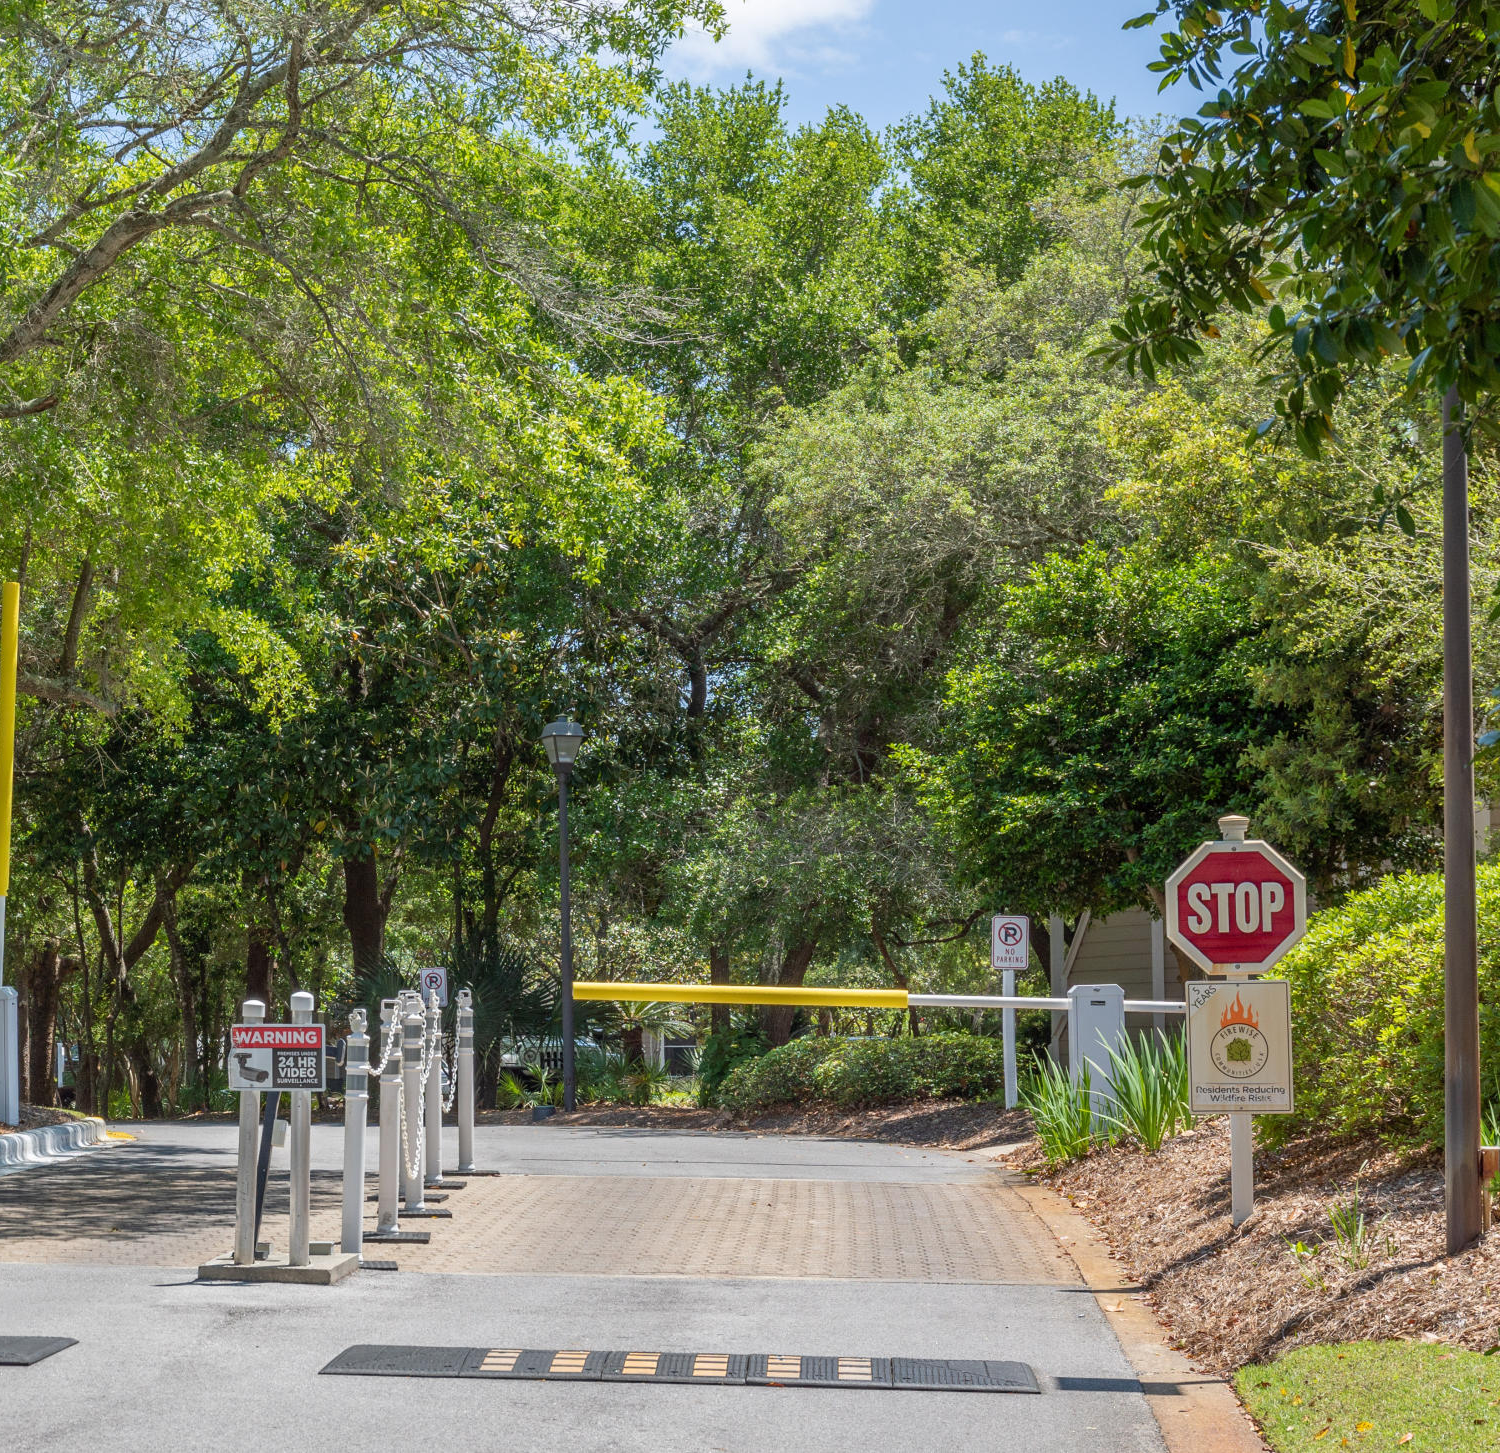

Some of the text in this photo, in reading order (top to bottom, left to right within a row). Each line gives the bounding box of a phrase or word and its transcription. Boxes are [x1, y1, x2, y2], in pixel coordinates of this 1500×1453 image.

[1187, 881, 1285, 934] STOP
[996, 956, 1024, 964] PARKING
[1193, 986, 1200, 996] 5
[1191, 985, 1217, 1009] YEARS
[236, 1031, 317, 1044] WARNING
[278, 1056, 316, 1067] 24 HR
[278, 1067, 316, 1078] VIDEO
[1195, 1085, 1286, 1095] Residents Reducing
[1210, 1094, 1246, 1102] Wildfire
